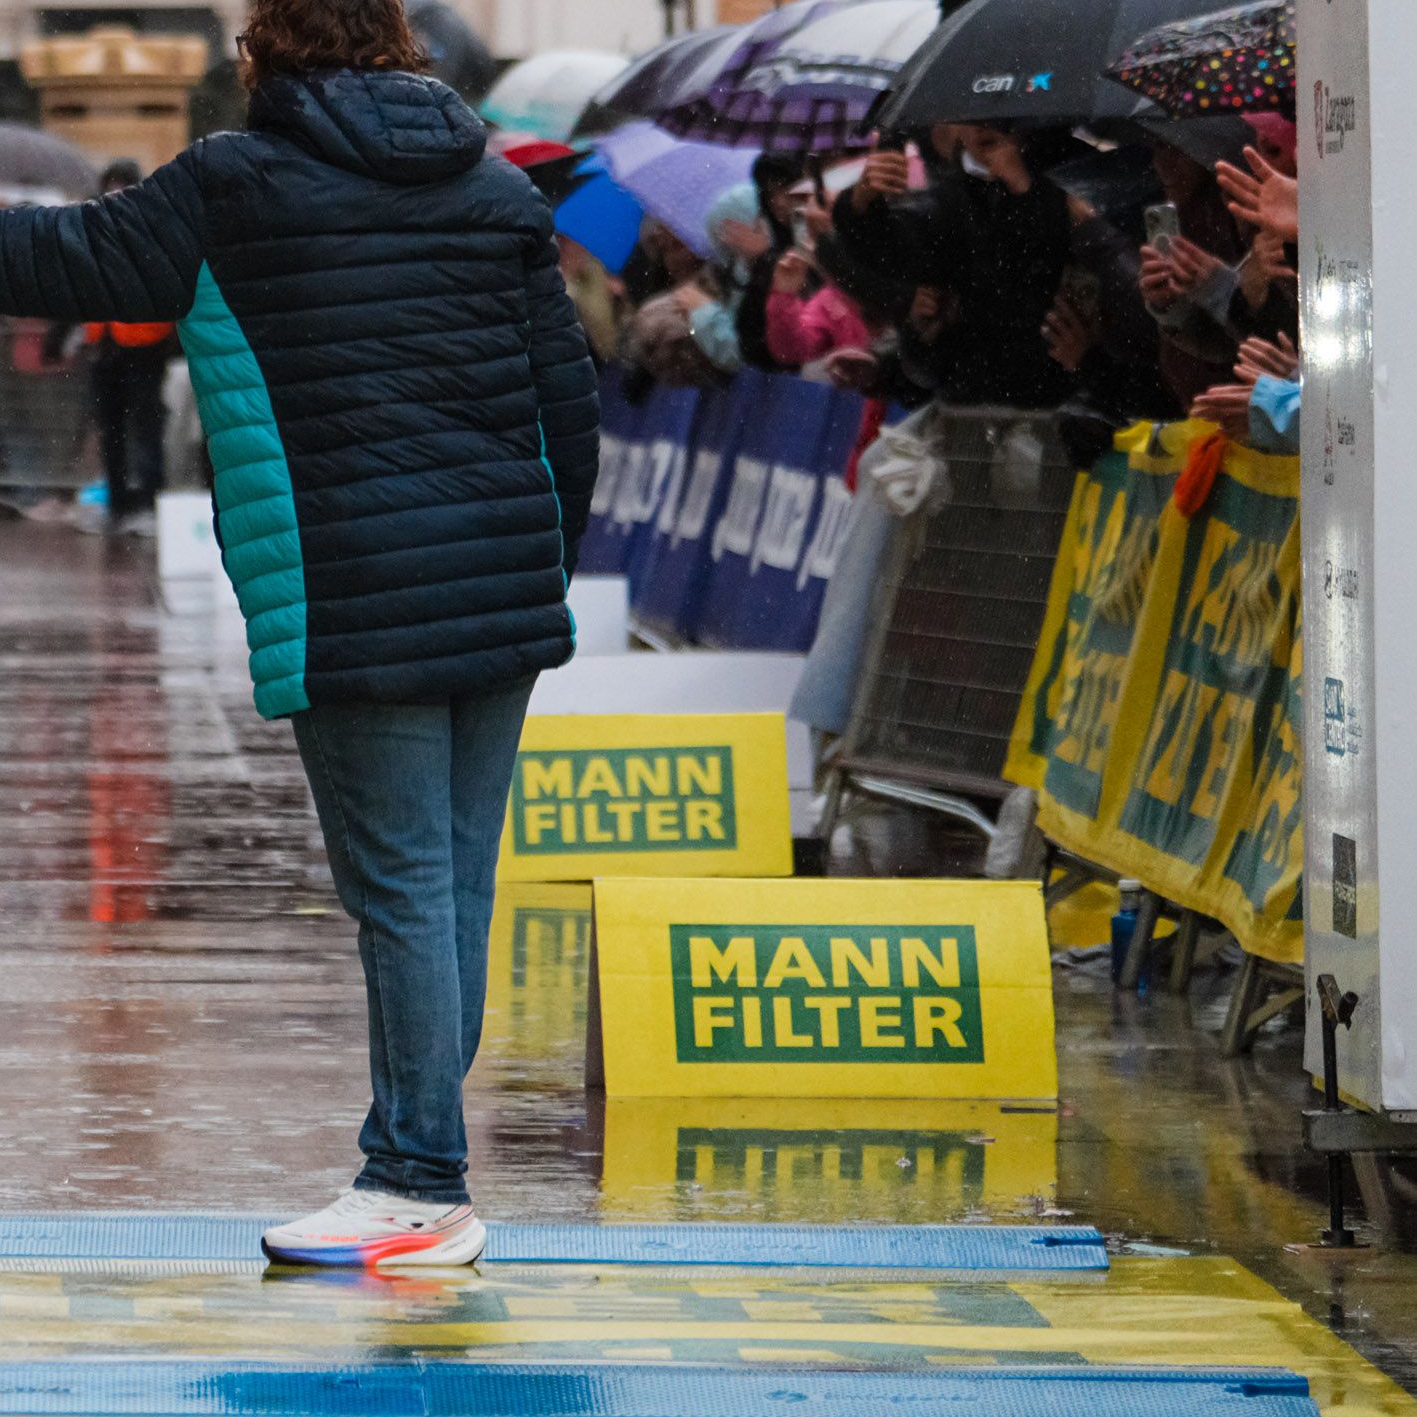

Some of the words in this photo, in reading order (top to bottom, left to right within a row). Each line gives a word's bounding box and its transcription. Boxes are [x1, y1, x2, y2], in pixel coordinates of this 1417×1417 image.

[521, 755, 721, 799] MANN
[524, 800, 725, 844] FILTER
[688, 937, 961, 988] MANN
[693, 996, 967, 1048] FILTER
